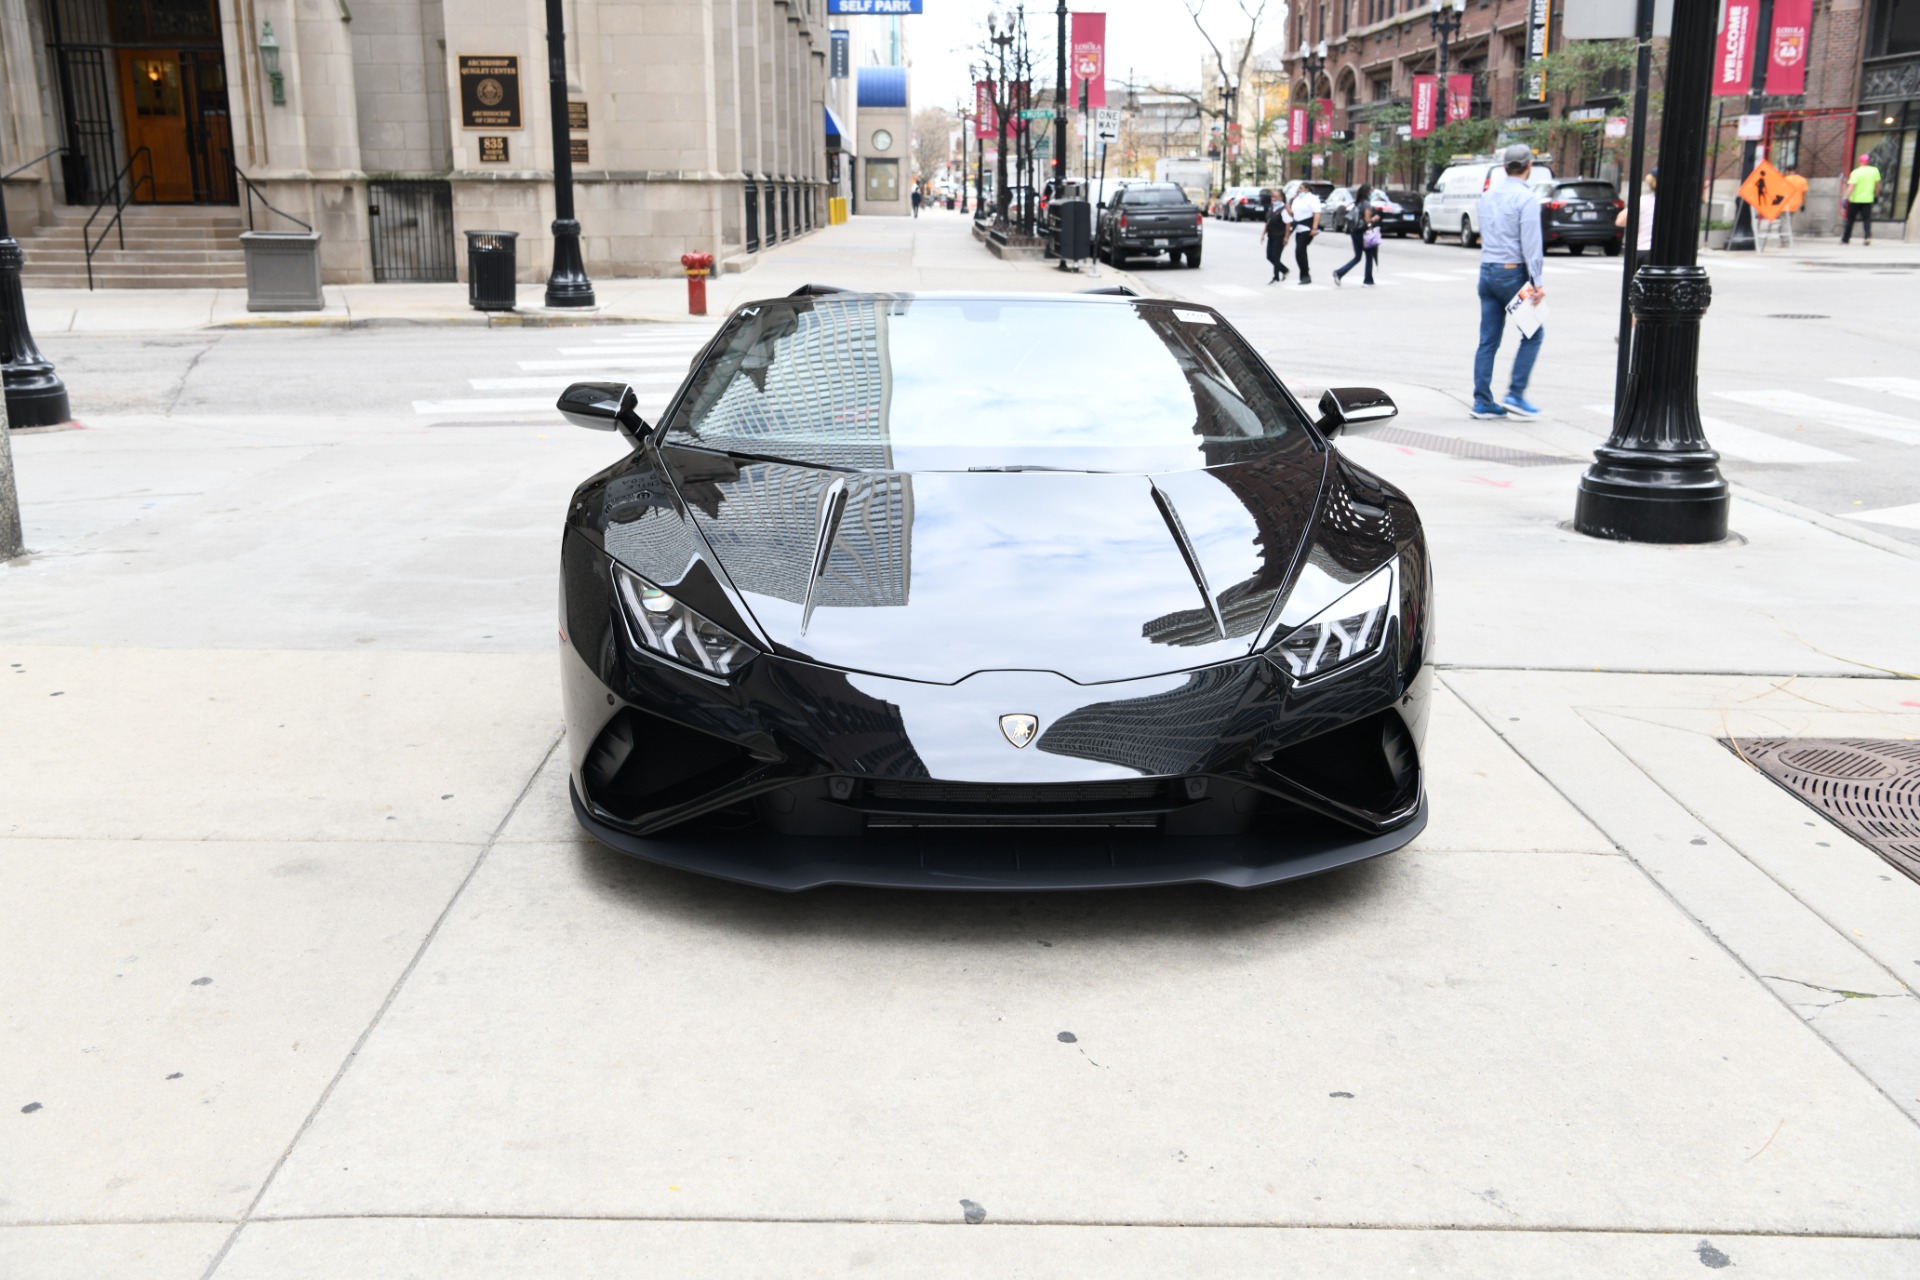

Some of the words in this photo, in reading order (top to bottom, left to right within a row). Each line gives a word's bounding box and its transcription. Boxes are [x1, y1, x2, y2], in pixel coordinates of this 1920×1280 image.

[839, 0, 872, 12] SELF
[874, 0, 912, 12] PARK
[1723, 6, 1742, 83] WELCOME
[467, 59, 509, 67] ARCHBISHOP
[1417, 83, 1427, 130] WELCOME
[1099, 111, 1118, 120] ONE
[1098, 121, 1117, 129] WAY
[484, 138, 503, 149] 835
